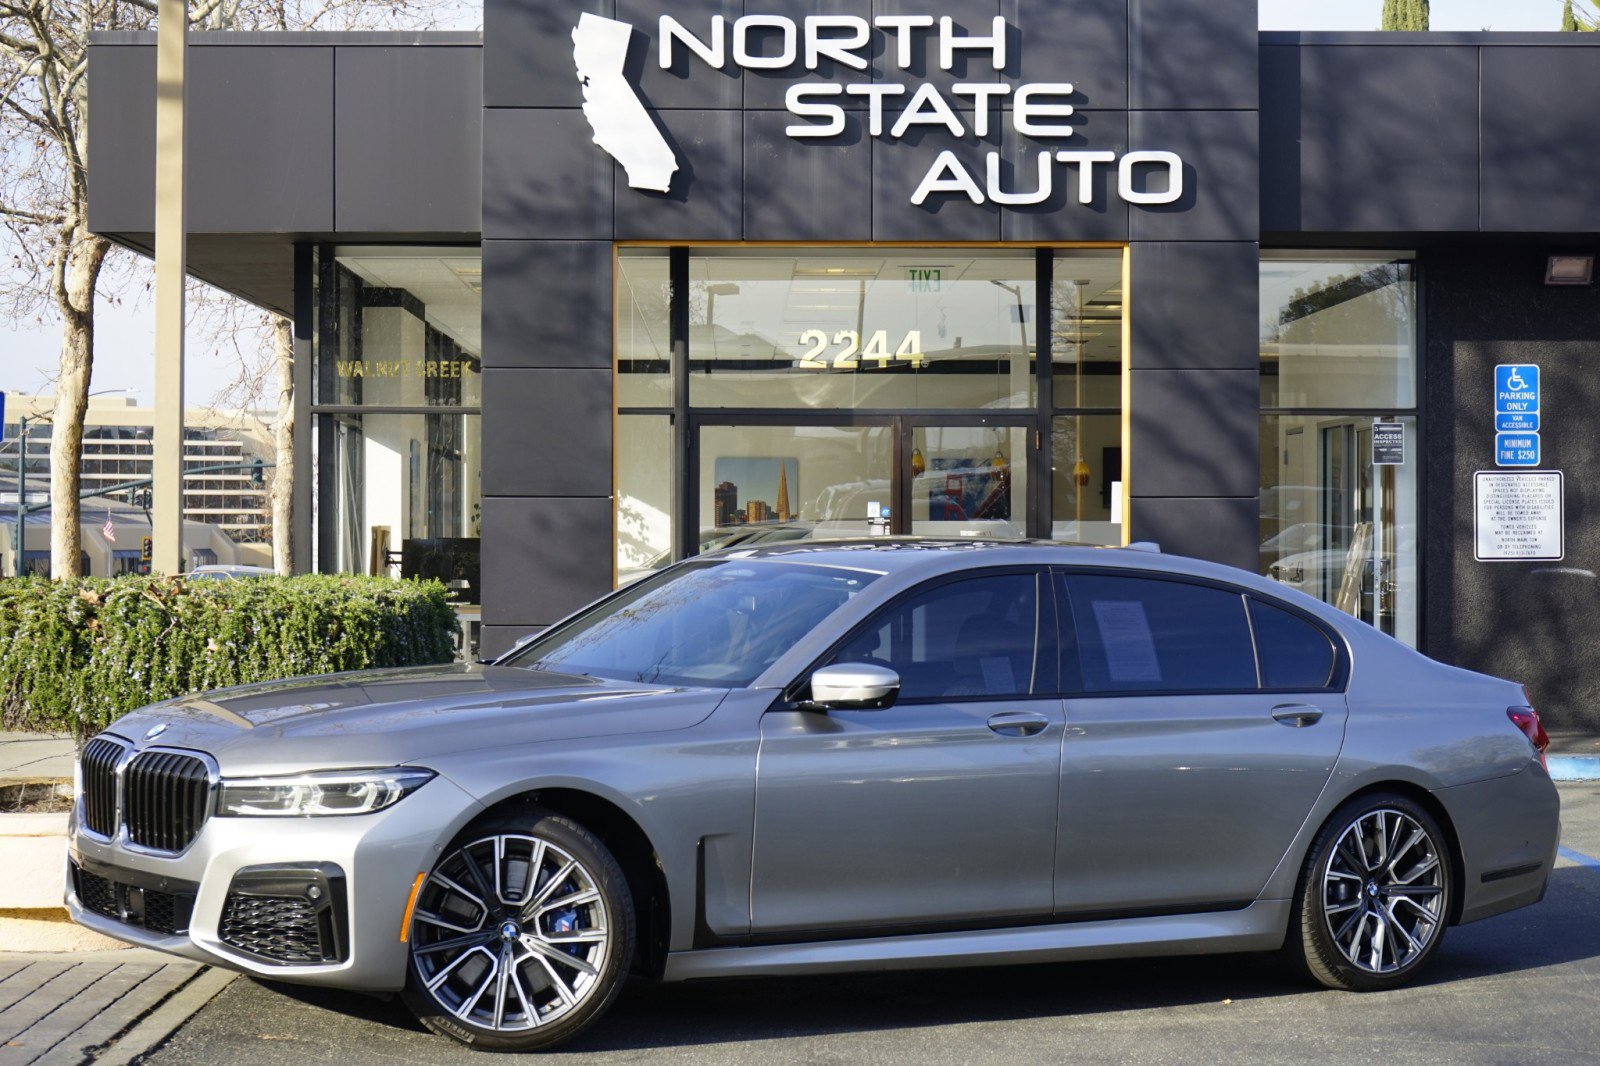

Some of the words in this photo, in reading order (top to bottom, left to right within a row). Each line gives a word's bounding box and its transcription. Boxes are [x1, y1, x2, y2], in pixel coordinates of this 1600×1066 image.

[658, 15, 1006, 70] NORTH
[785, 83, 1074, 137] STATE
[910, 150, 1183, 205] AUTO
[799, 329, 925, 369] 2244
[337, 360, 411, 378] WALNUT
[415, 360, 472, 378] CREEK
[1499, 392, 1536, 400] PARKING
[1506, 402, 1528, 411] ONLY
[1504, 439, 1532, 448] MINIMUM
[1500, 450, 1514, 460] FINE
[1517, 450, 1535, 460] $250
